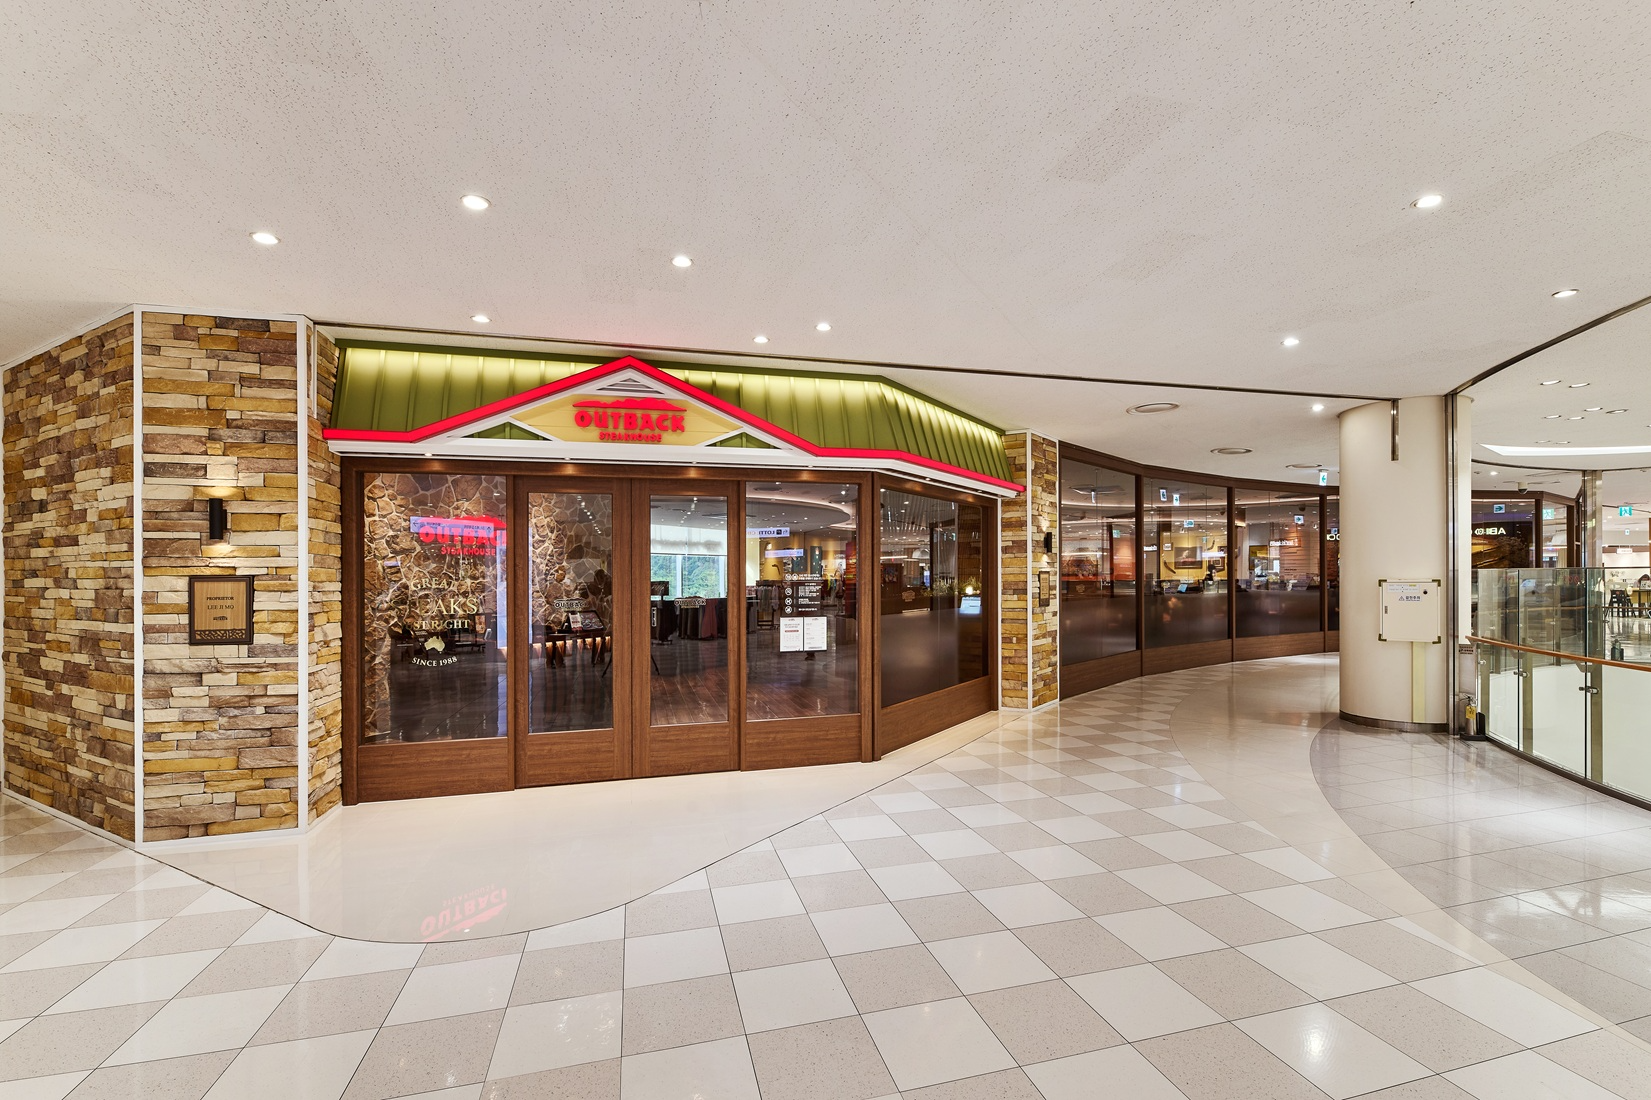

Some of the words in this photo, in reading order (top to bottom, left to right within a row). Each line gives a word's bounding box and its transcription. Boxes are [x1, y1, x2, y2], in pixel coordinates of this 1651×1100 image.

[574, 410, 685, 433] OUTBACK
[598, 431, 662, 442] STEAKHOUSE
[441, 547, 496, 556] STEAKHOUSE
[411, 577, 455, 591] GREAT
[431, 619, 471, 630] RIGHT
[411, 656, 438, 667] SINCE
[439, 655, 458, 667] 1988
